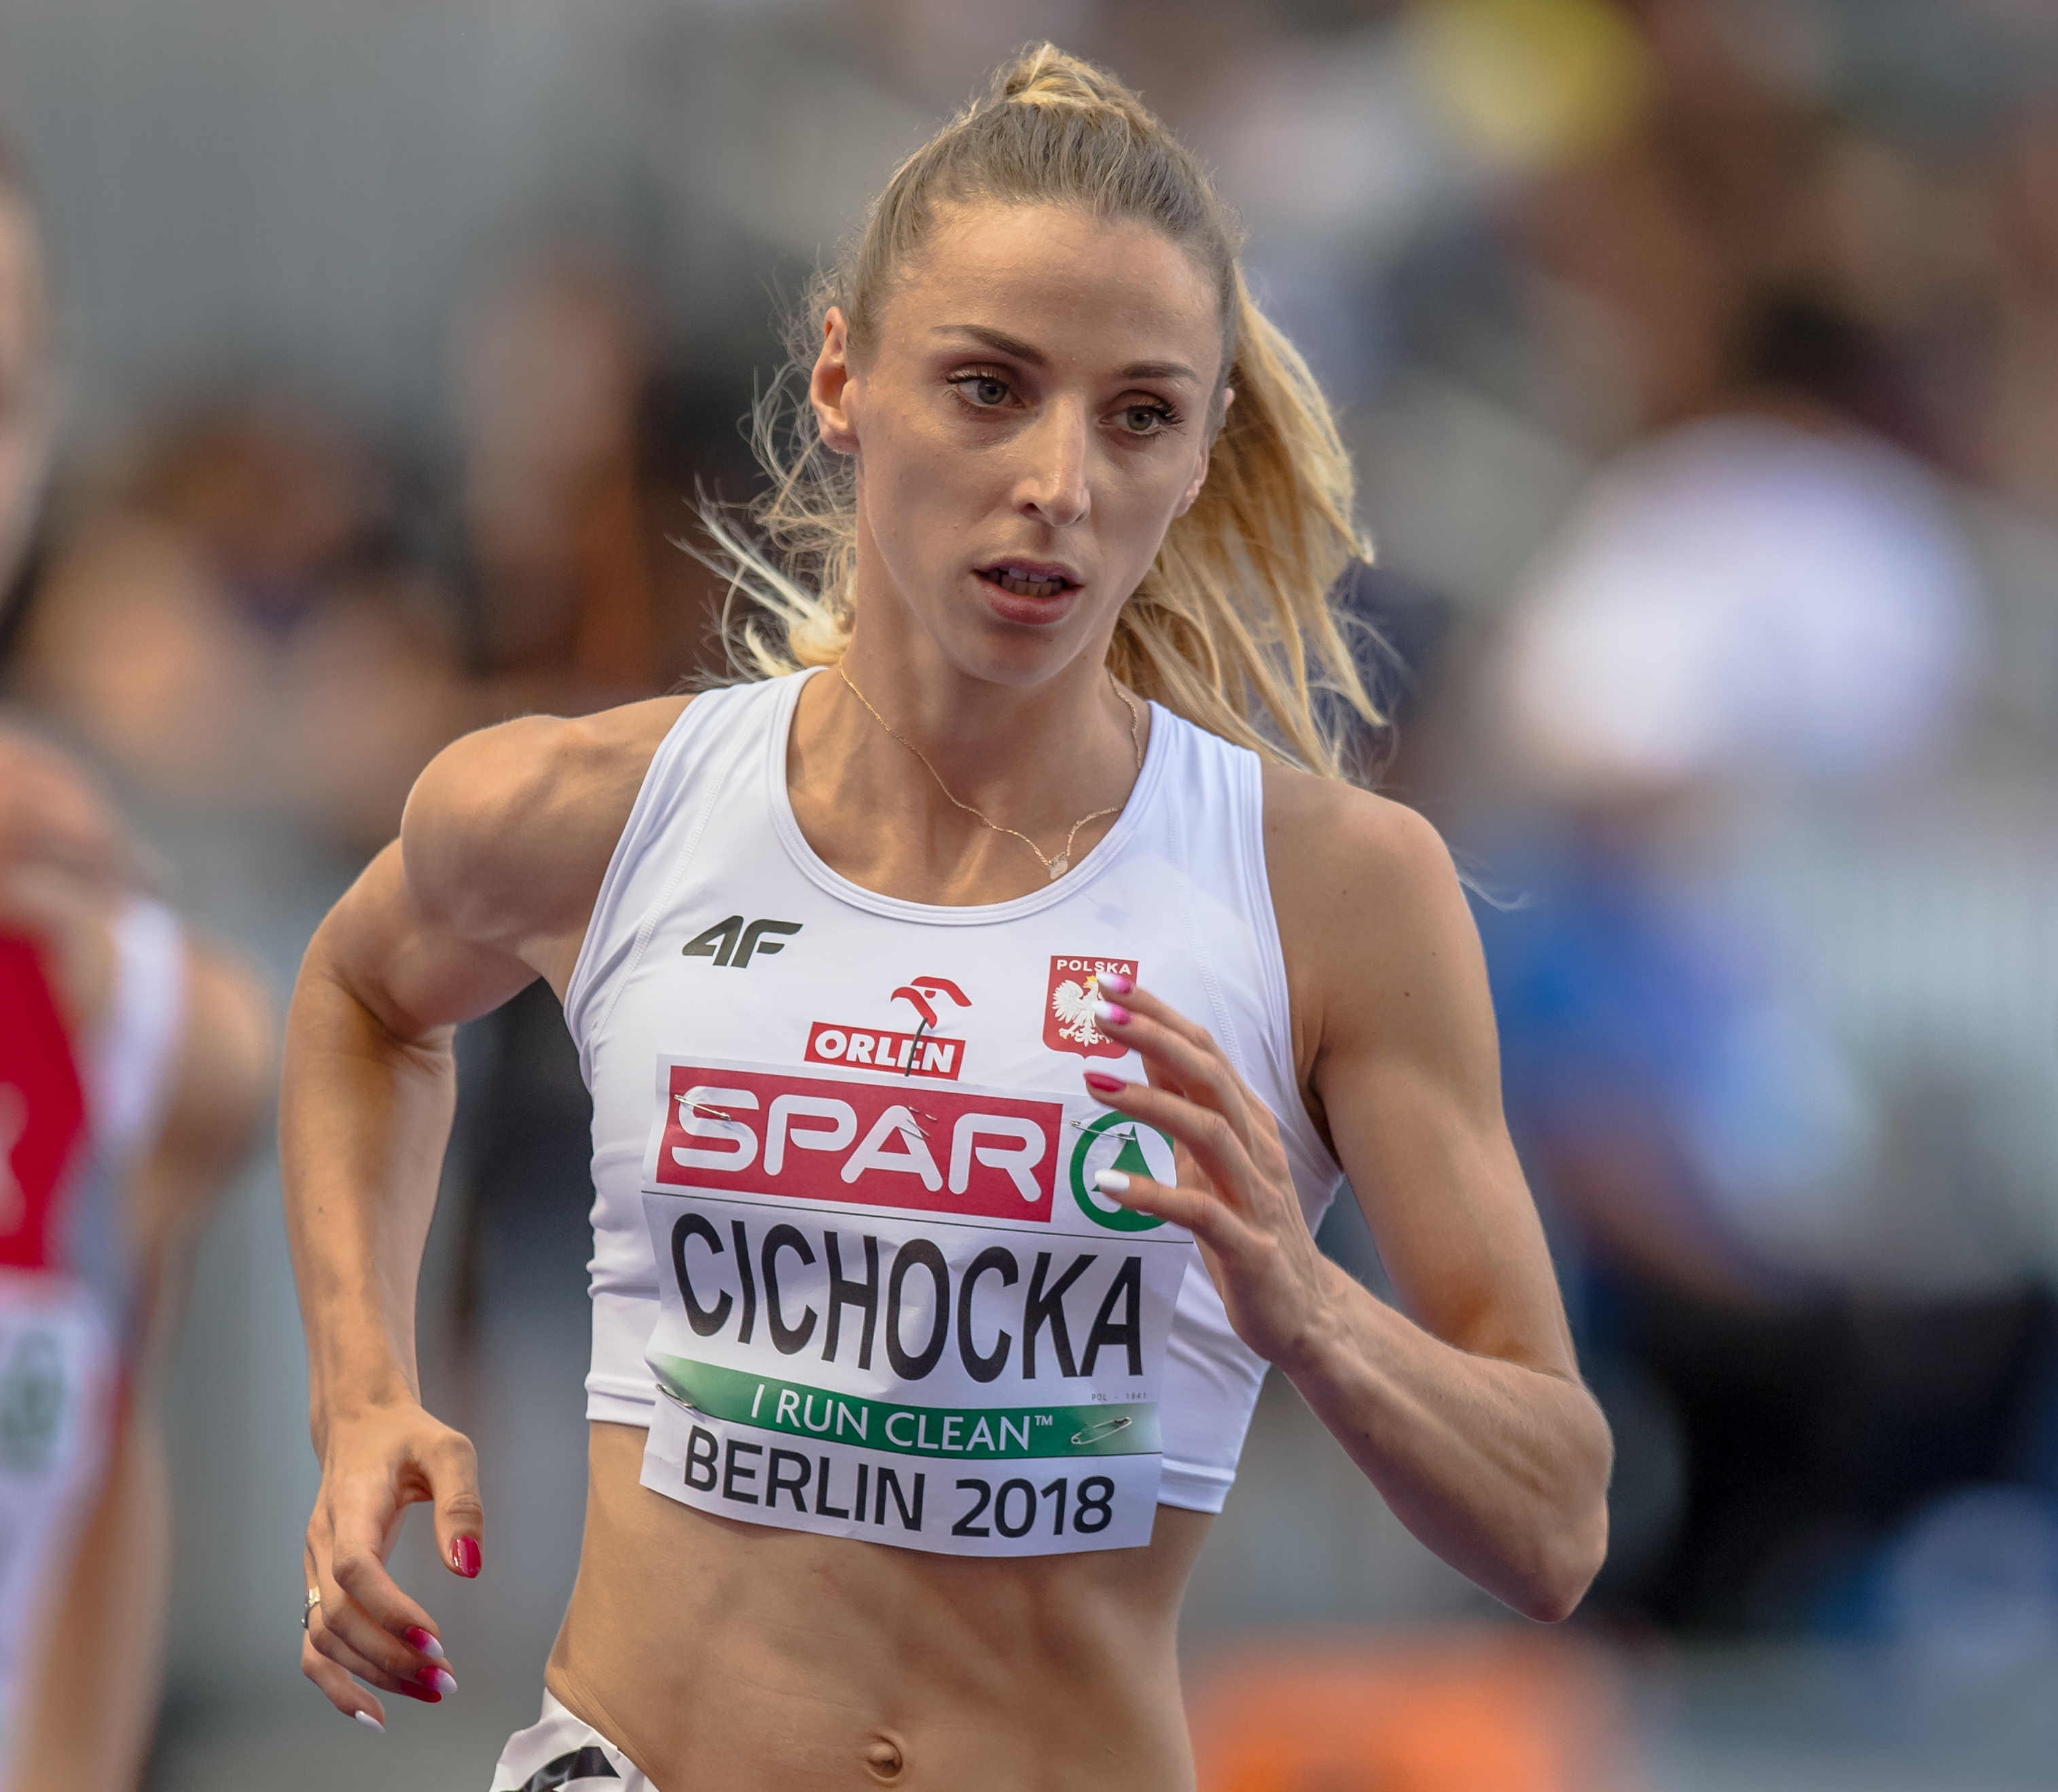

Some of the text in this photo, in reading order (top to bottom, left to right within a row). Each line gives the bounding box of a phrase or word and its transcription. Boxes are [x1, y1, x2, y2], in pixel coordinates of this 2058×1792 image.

[681, 915, 804, 969] 4F
[1056, 959, 1132, 975] POLSKA
[814, 1029, 955, 1074] ORLEN
[671, 1085, 1047, 1203] SPAR
[670, 1212, 1144, 1383] CICHOCKA
[751, 1383, 765, 1419] I
[775, 1389, 869, 1442] RUN
[1091, 1393, 1108, 1401] POL
[683, 1425, 1116, 1539] BERLIN 2018
